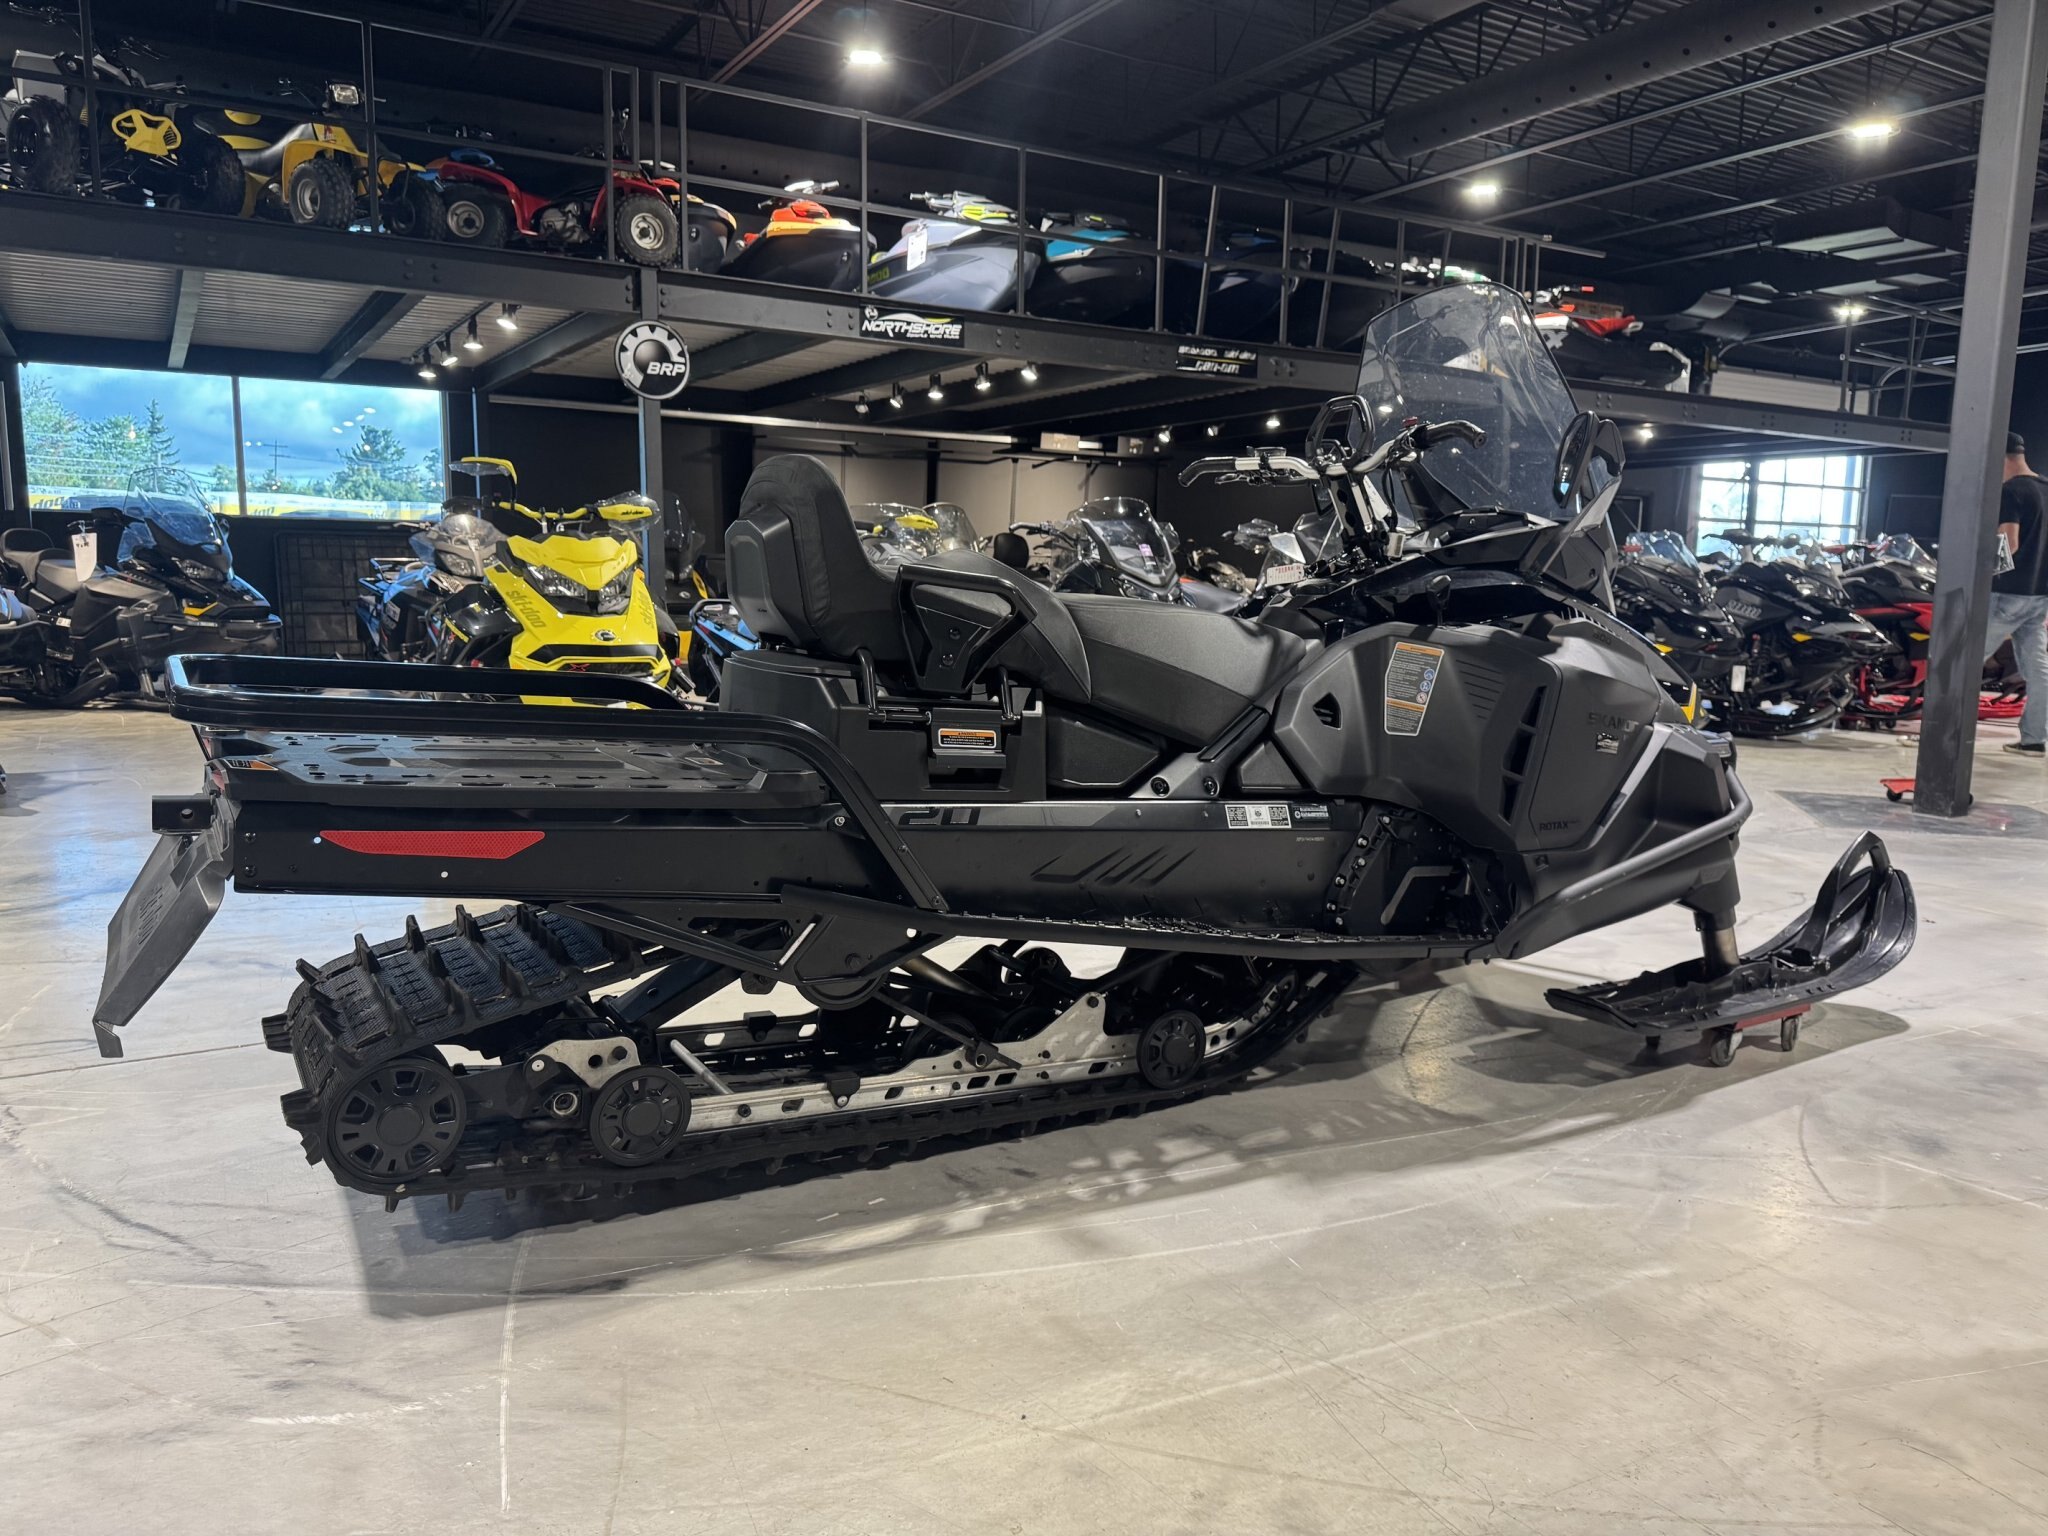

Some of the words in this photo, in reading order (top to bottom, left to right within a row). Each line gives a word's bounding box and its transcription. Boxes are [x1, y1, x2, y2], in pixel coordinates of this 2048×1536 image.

[862, 319, 962, 338] NORTHSHORE
[647, 361, 686, 377] BRP
[506, 590, 547, 629] ski-doo
[1587, 711, 1639, 732] SKAN
[1540, 820, 1569, 831] ROTAX
